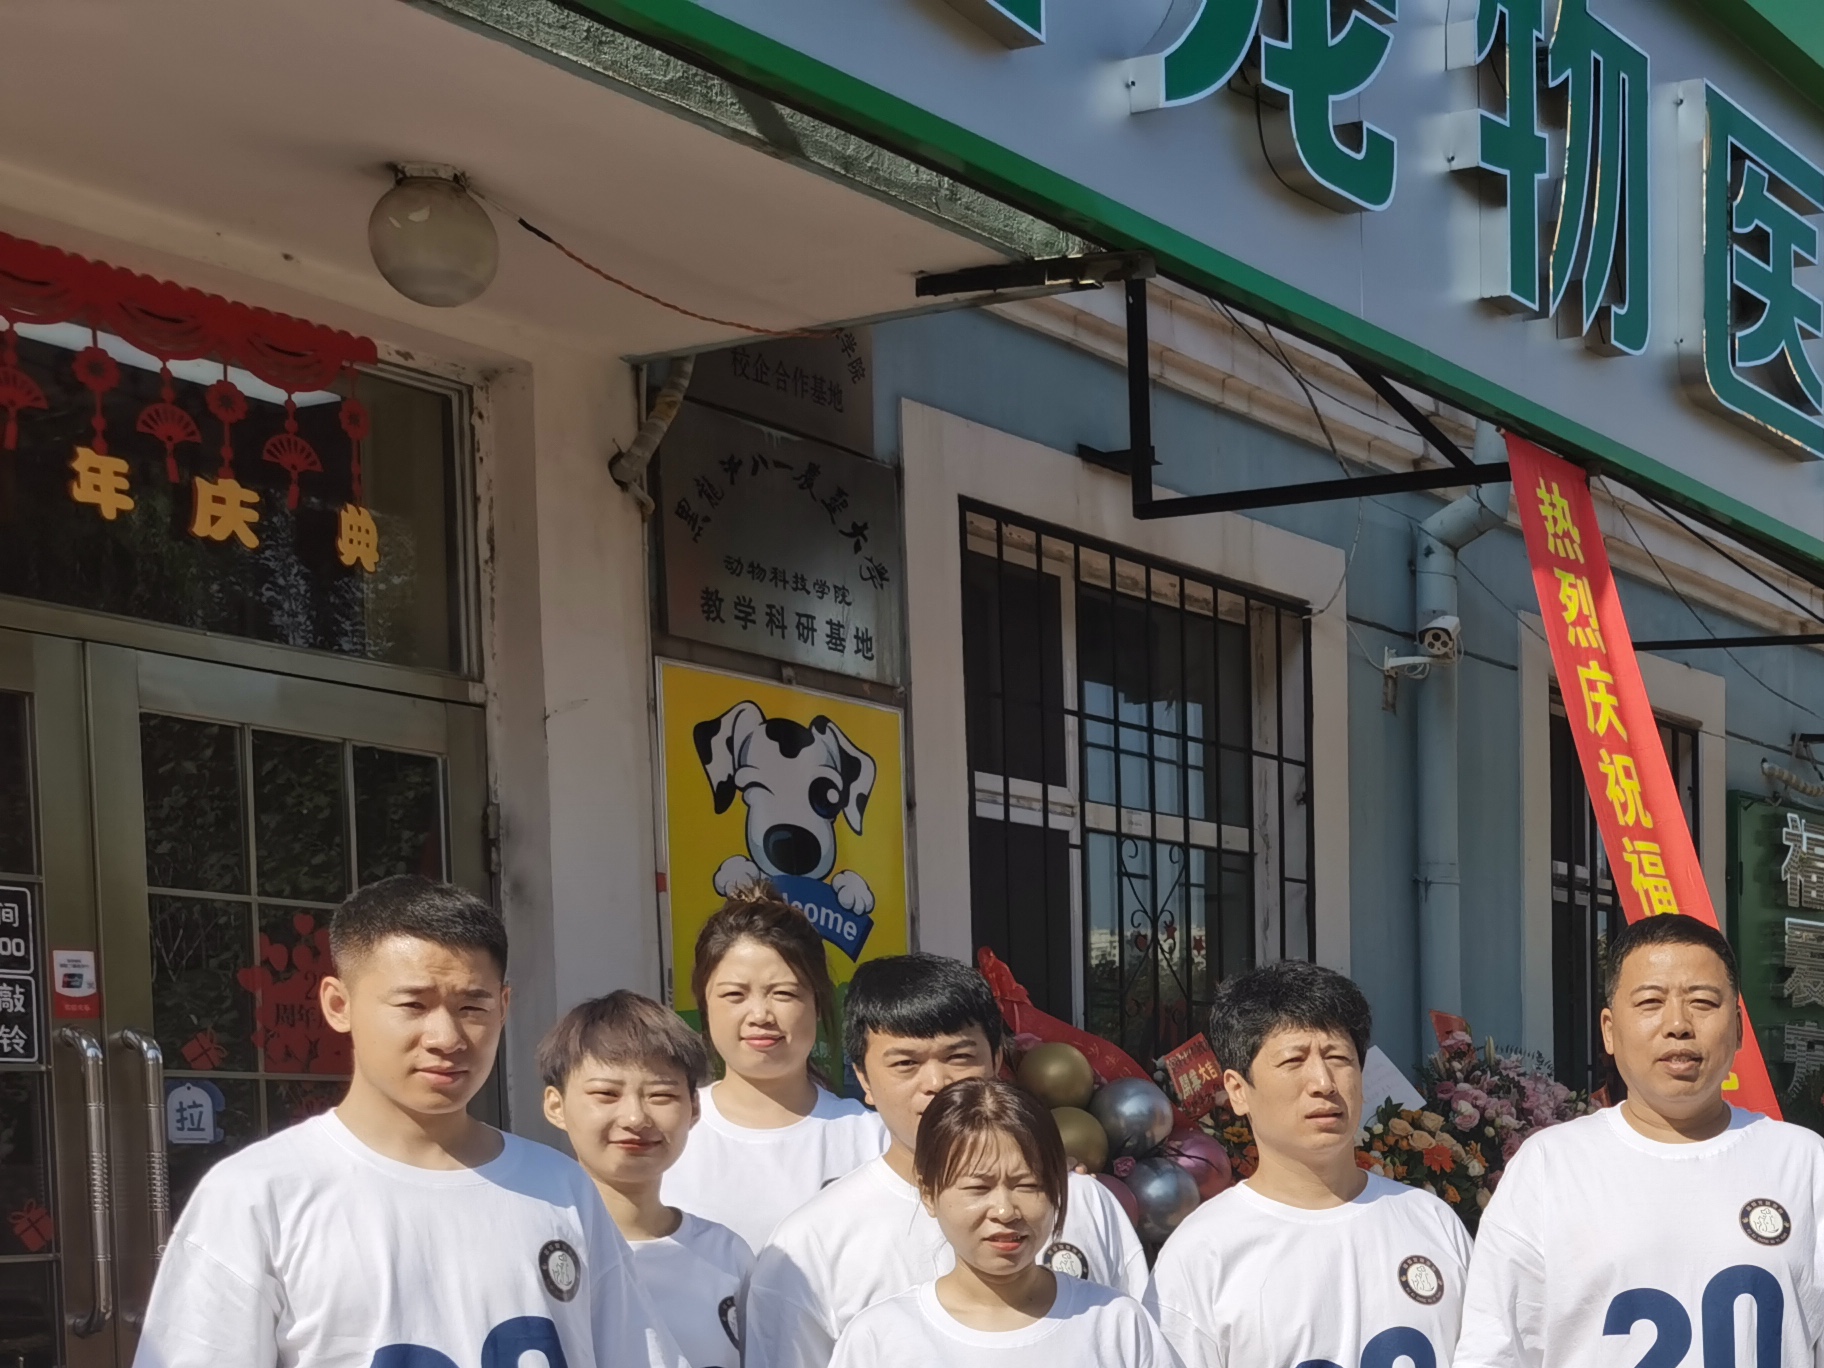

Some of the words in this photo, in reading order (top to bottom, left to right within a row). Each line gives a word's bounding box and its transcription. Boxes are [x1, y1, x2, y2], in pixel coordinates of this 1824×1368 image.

[731, 348, 844, 413] 校企合作基地
[724, 555, 852, 606] 动物科技学院
[700, 586, 875, 662] 教学科研基地
[275, 1002, 329, 1031] 周年
[176, 1101, 206, 1132] 拉
